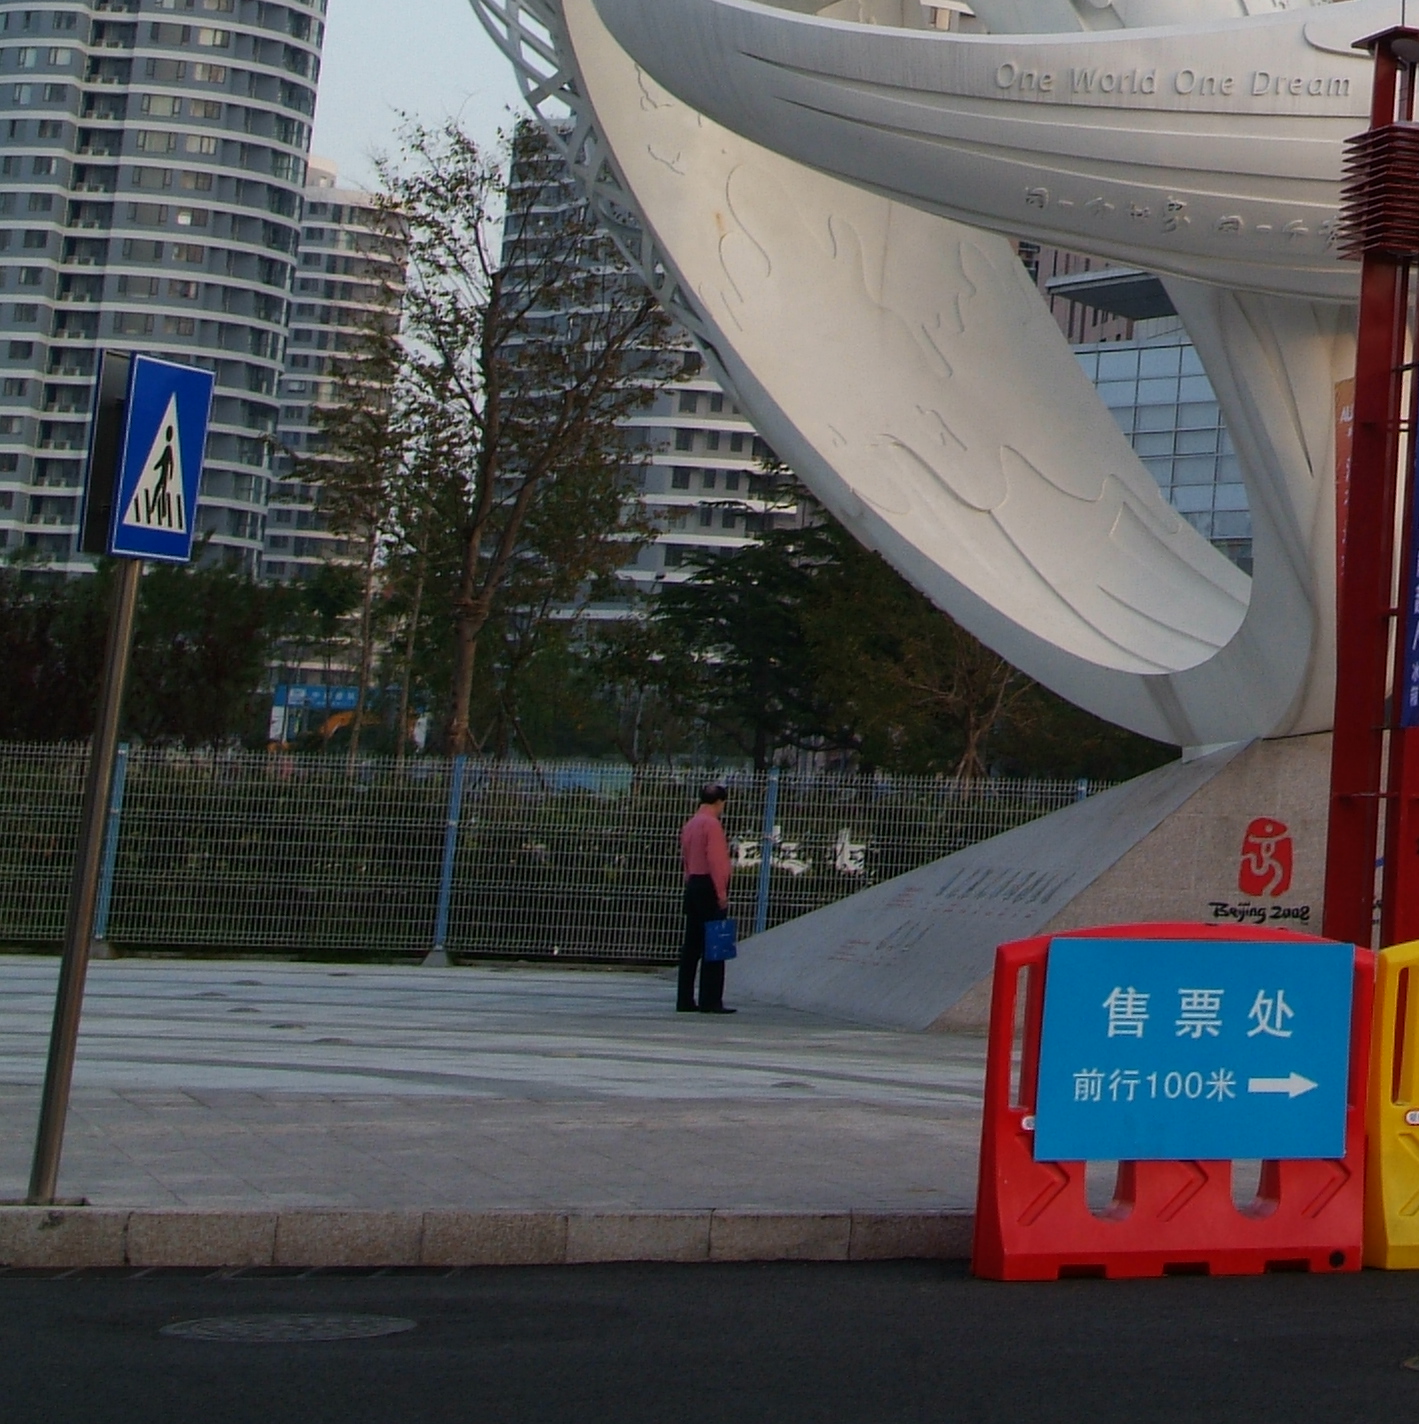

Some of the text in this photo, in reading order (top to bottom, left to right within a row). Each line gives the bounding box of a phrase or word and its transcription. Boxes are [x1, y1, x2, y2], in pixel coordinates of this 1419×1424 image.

[995, 61, 1352, 98] One World One Dream
[1208, 901, 1311, 924] Beijing 2008
[1102, 986, 1296, 1038] 售票处
[1072, 1067, 1237, 1102] 前行100米
